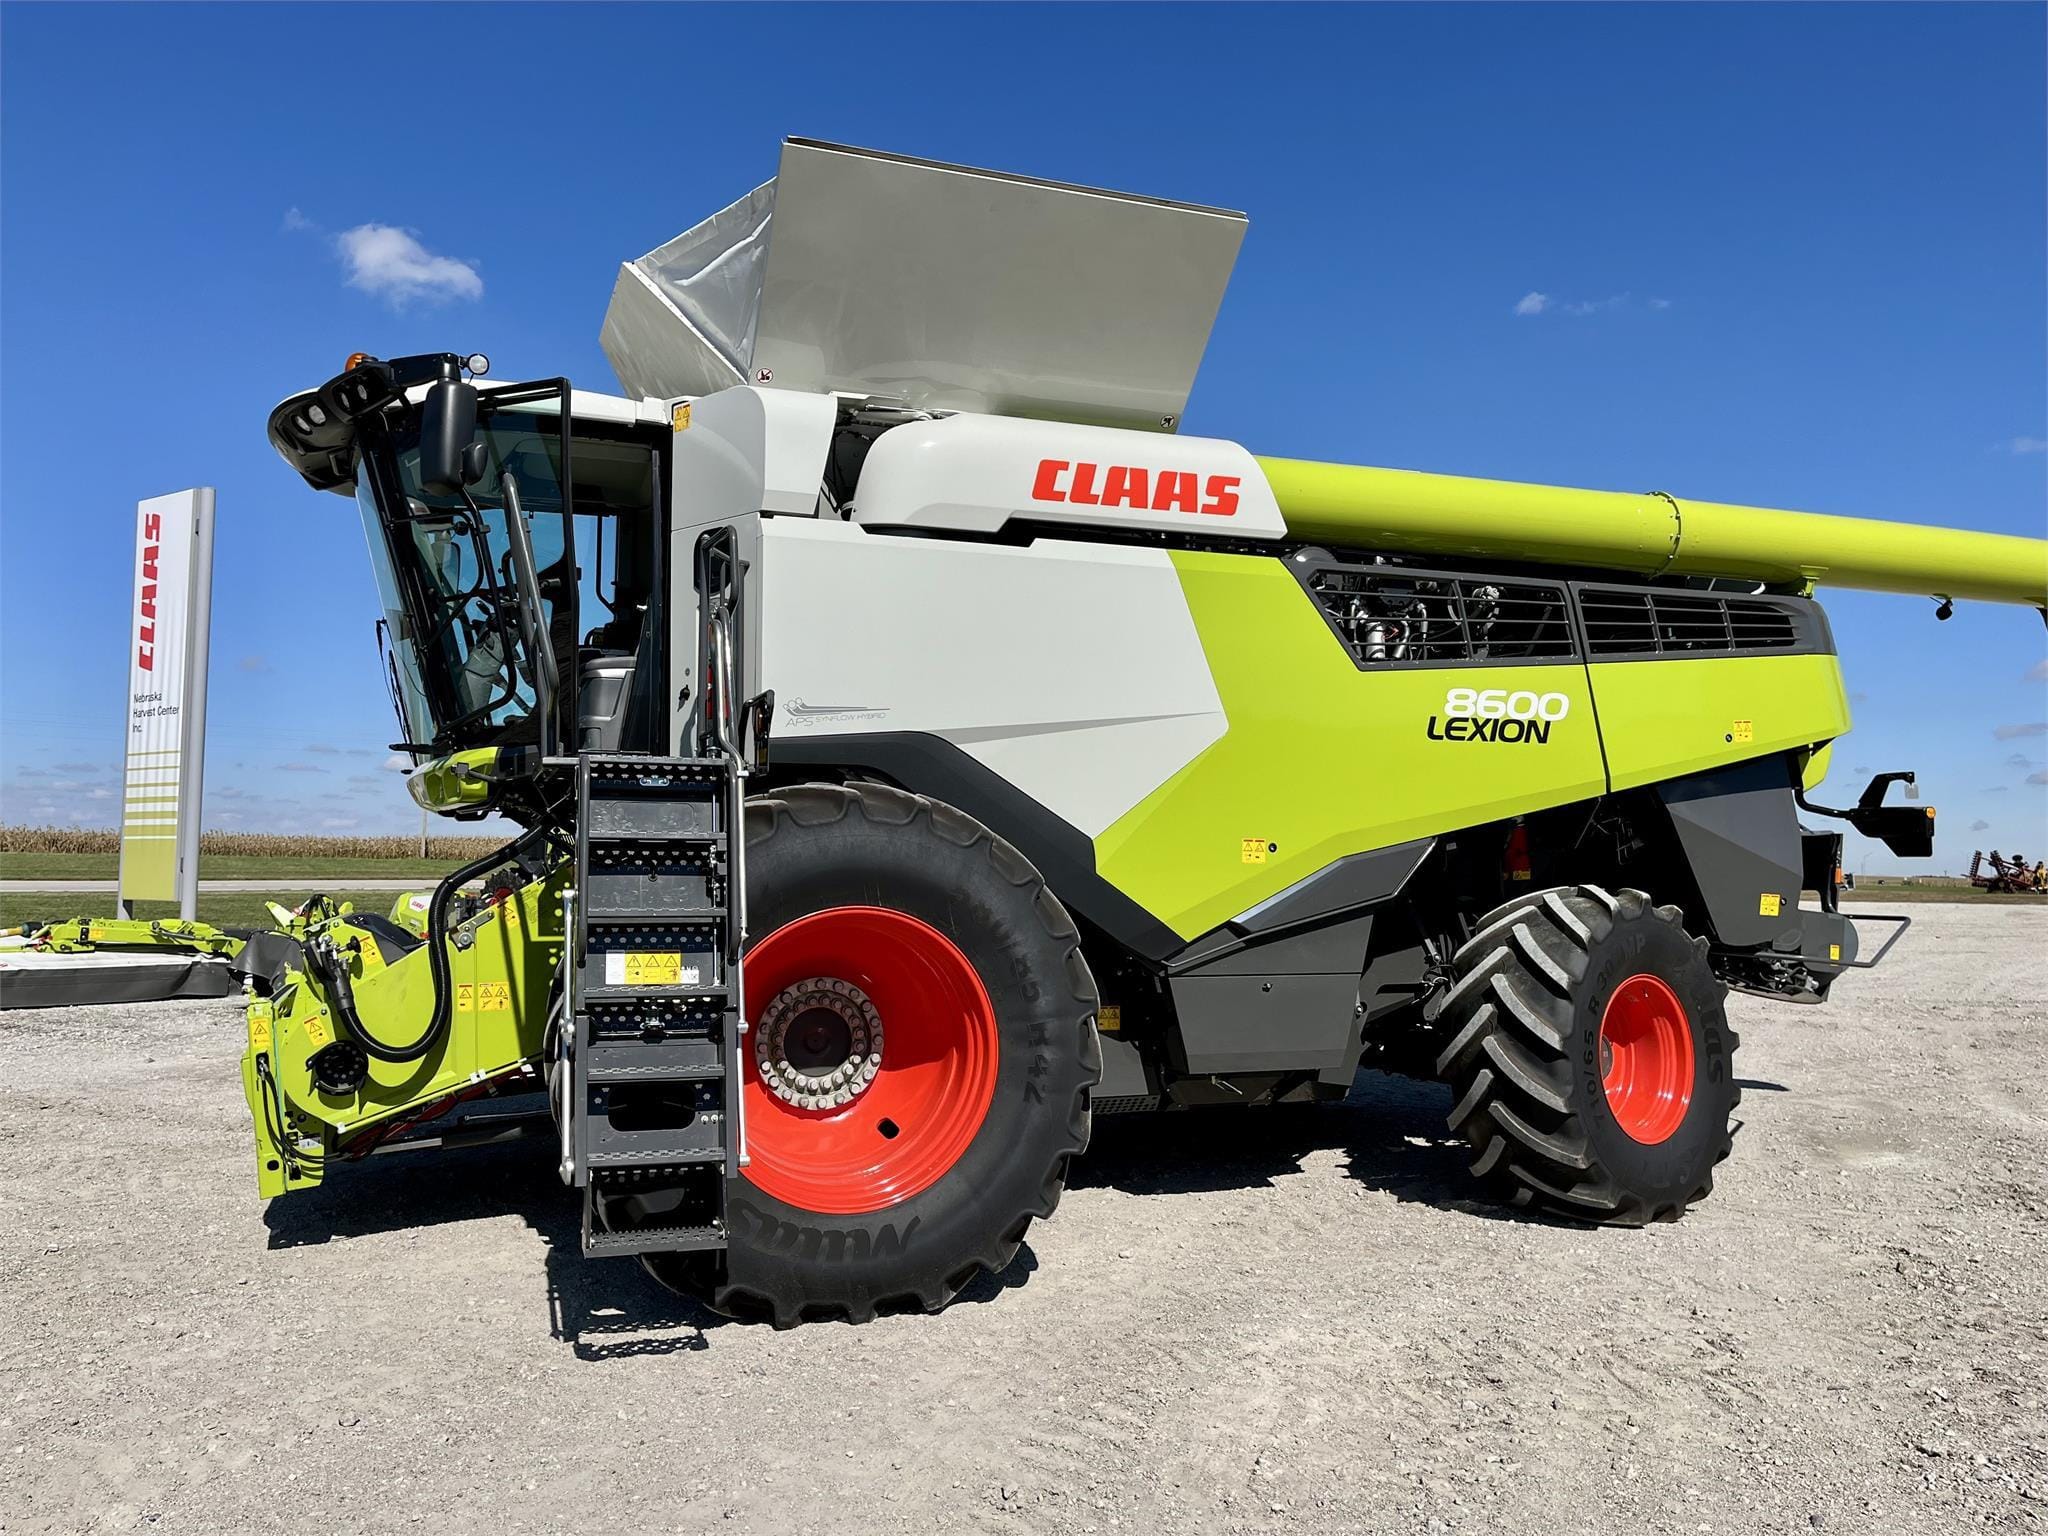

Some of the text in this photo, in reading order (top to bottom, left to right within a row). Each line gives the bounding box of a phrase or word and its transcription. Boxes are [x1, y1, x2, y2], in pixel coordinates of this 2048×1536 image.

[1032, 459, 1241, 516] CLAAS
[139, 513, 161, 672] CLAAS
[133, 705, 179, 718] Harvest Center
[134, 692, 162, 703] Nebraska
[1444, 688, 1570, 722] 8600
[785, 716, 814, 728] APS
[815, 714, 856, 723] SYNFLOW
[1427, 716, 1551, 744] LEXION
